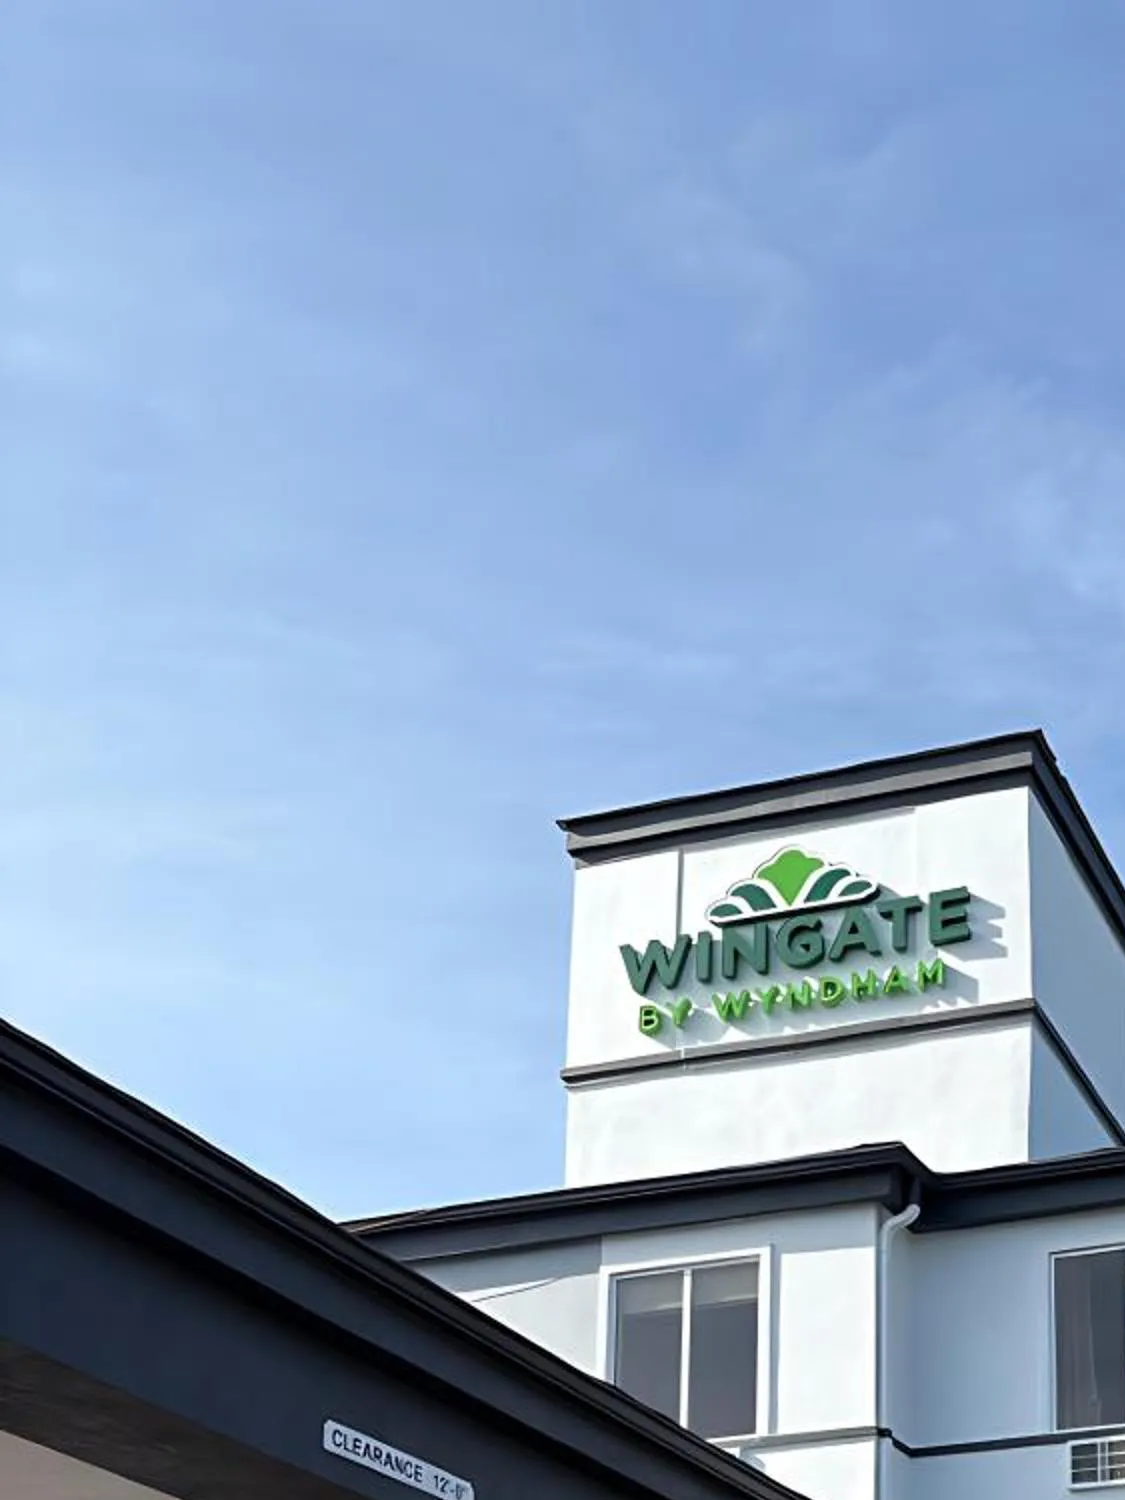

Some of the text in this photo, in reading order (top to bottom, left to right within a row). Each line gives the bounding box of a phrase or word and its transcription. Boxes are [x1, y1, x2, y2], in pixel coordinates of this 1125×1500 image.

[618, 886, 971, 996] WINGATE
[639, 959, 945, 1037] BY WYNDHAM
[331, 1428, 423, 1483] CLEARANCE
